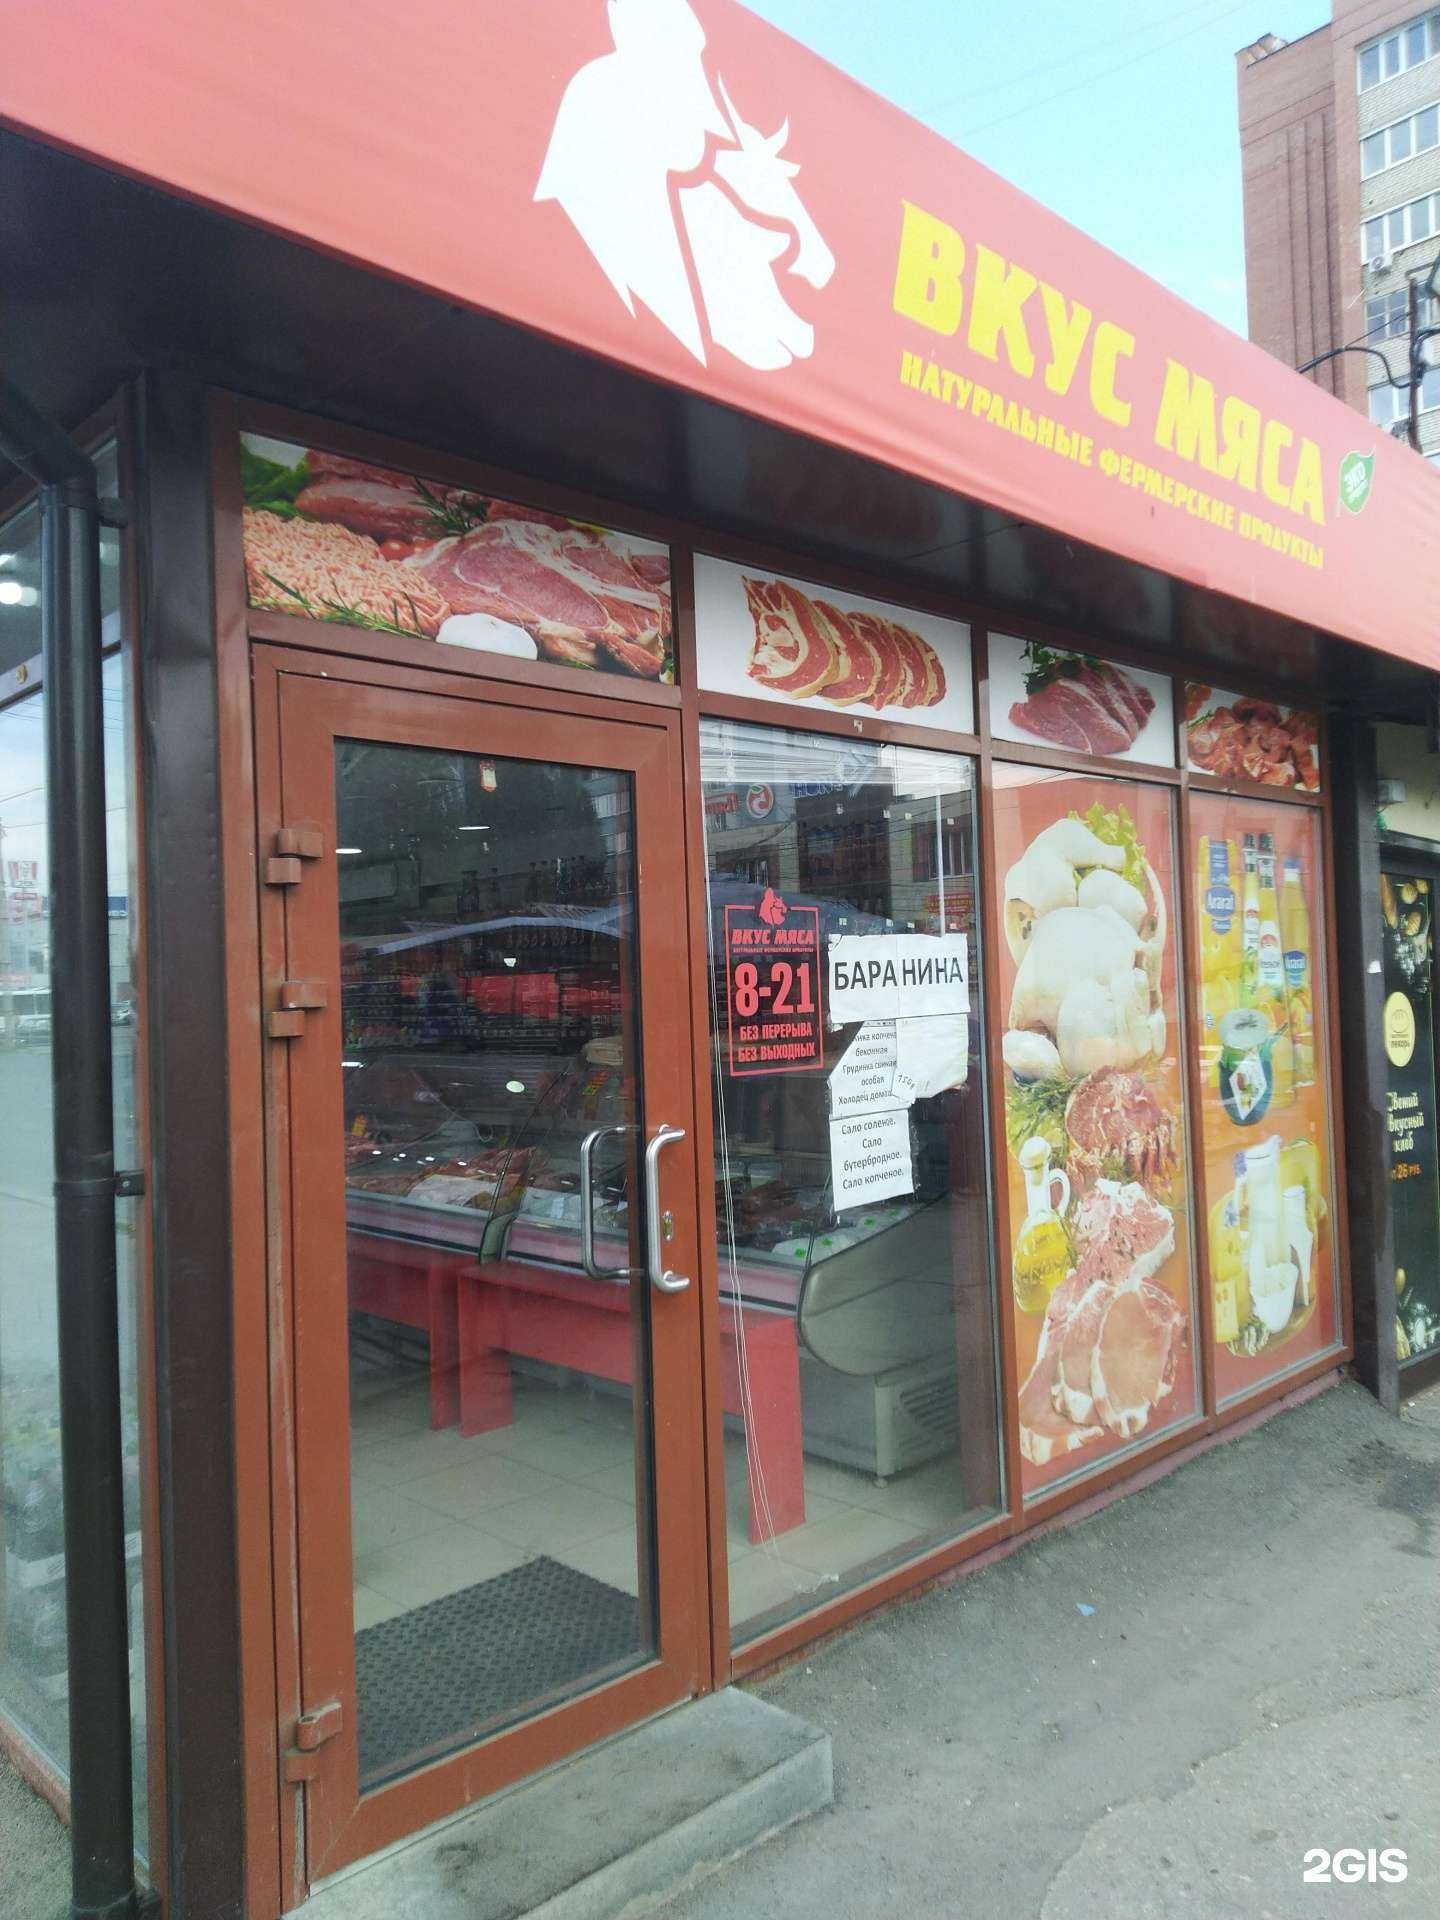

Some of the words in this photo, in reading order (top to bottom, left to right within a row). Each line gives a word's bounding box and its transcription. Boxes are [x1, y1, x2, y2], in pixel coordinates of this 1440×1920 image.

[892, 198, 1135, 428] ВКУС
[1153, 357, 1327, 526] МЯСА
[900, 351, 1093, 468] НАТУРАЛЬНЫЕ
[1098, 447, 1235, 532] ФЕРМЕРСКИЕ
[1238, 512, 1325, 570] ПРОДУКТЫ
[732, 929, 771, 945] ВКУС
[774, 929, 814, 945] МЯСА
[833, 957, 964, 991] БАРАНИНА
[734, 962, 815, 1017] 8-21
[740, 1024, 759, 1041] БЕЗ
[762, 1022, 813, 1040] ПЕРЕРЫВА
[738, 1046, 758, 1063] БЕЗ
[760, 1042, 815, 1060] ВЫХОДНЫХ
[838, 1090, 869, 1105] Холодец
[841, 1122, 862, 1135] Сало
[862, 1137, 882, 1149] Сало
[842, 1177, 863, 1190] Сало
